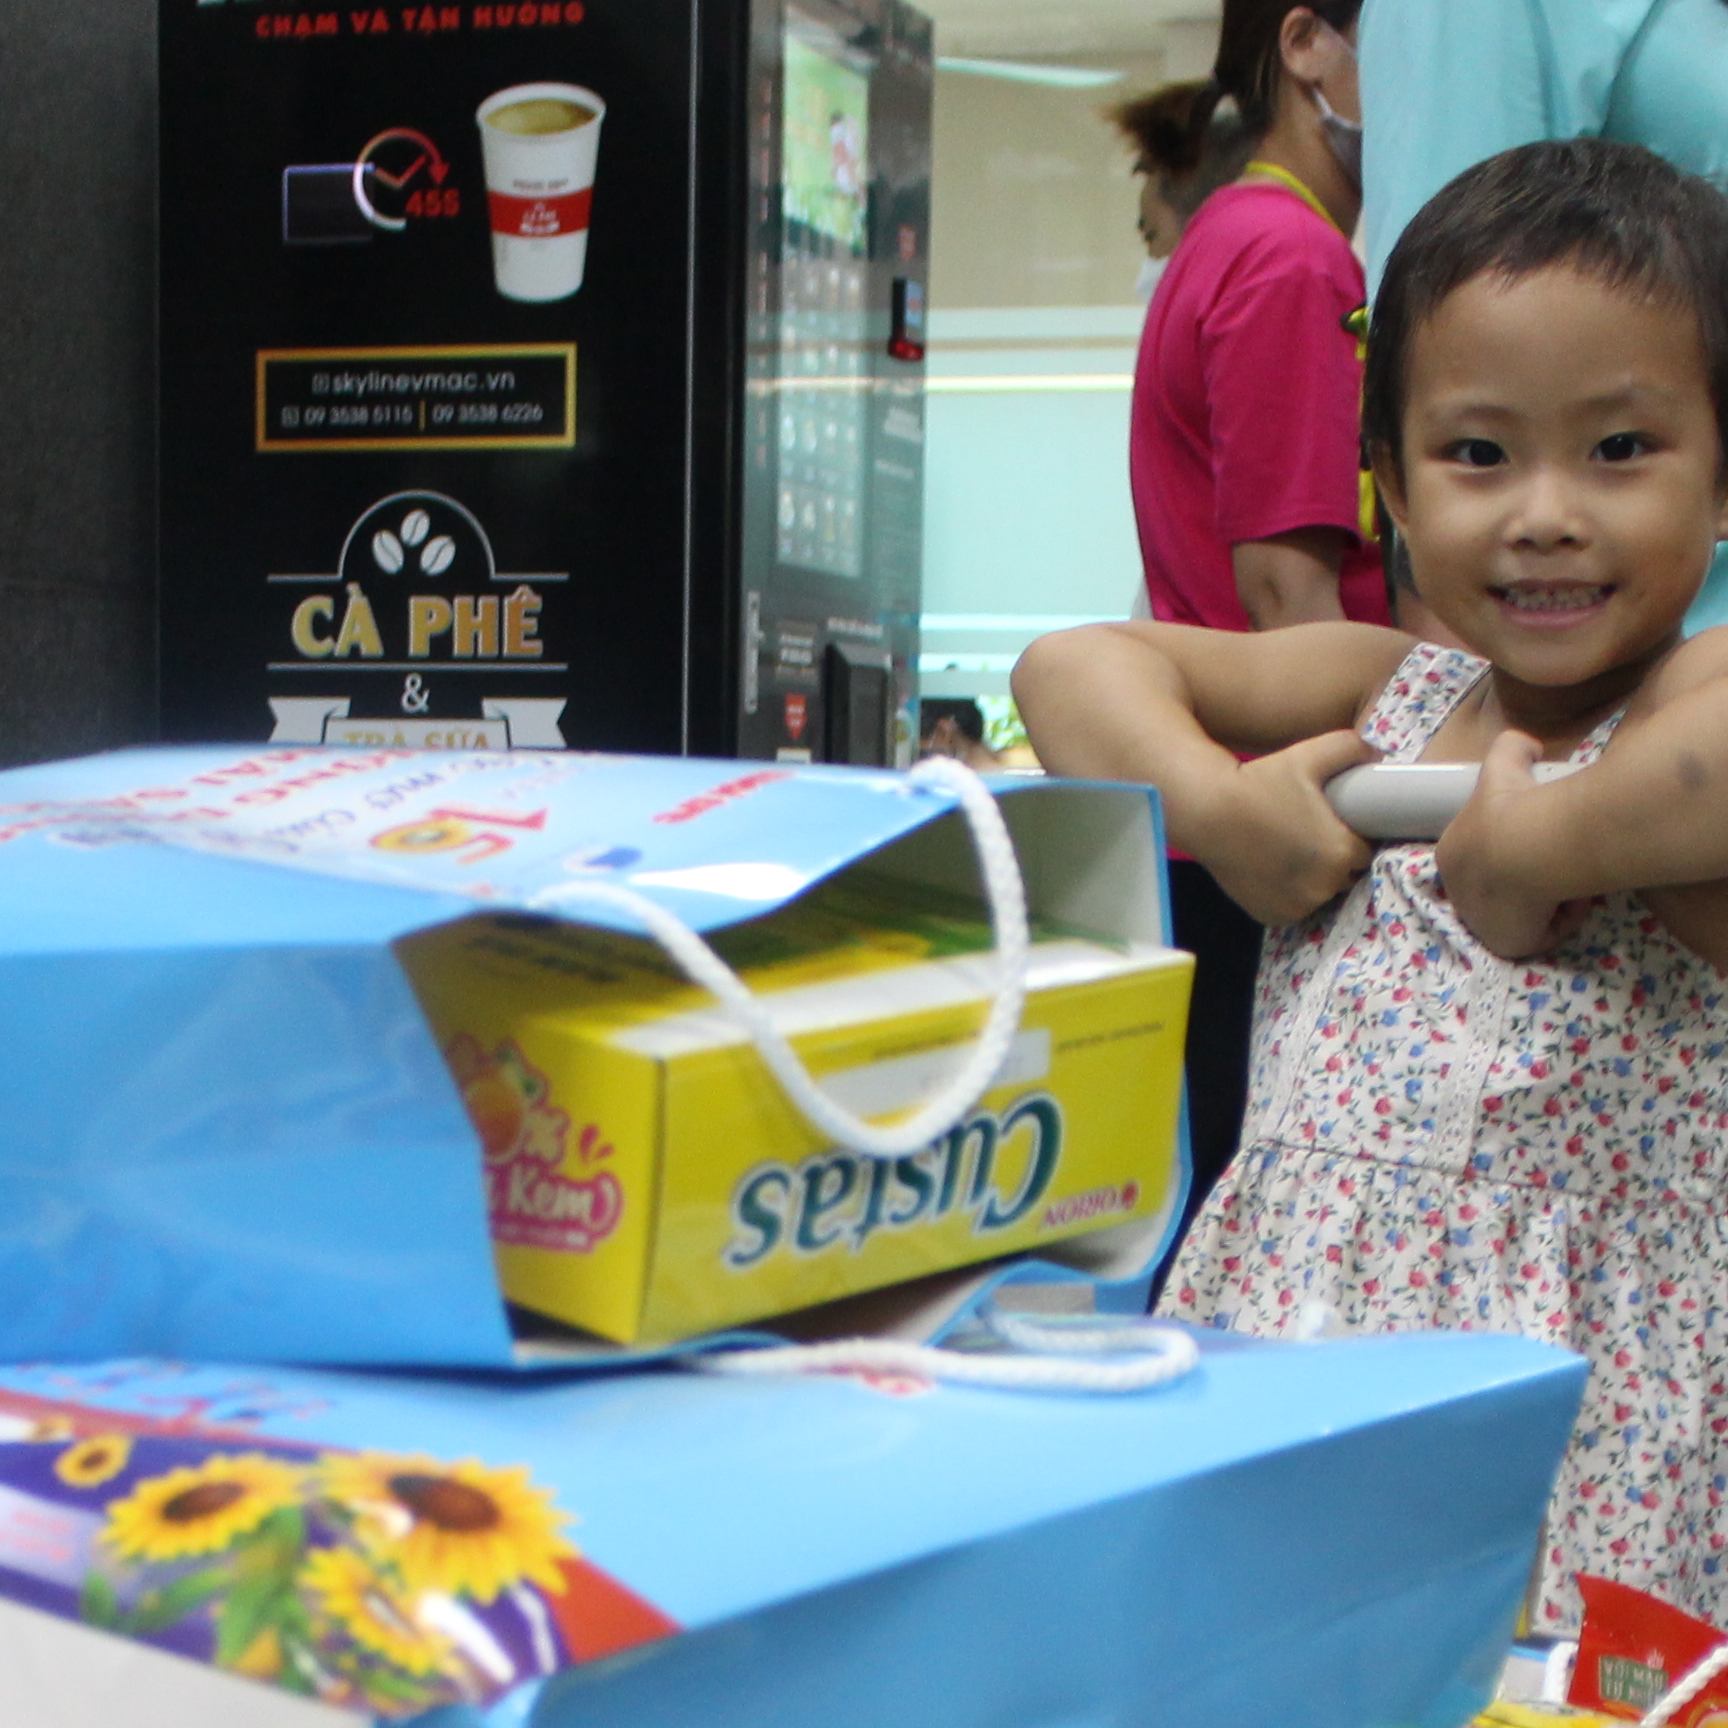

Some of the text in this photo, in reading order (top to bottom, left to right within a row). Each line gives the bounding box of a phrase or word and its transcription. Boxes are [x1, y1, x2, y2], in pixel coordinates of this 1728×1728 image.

[292, 582, 544, 659] CÀ PHÊ
[400, 672, 430, 713] &
[726, 1090, 1064, 1268] Custas
